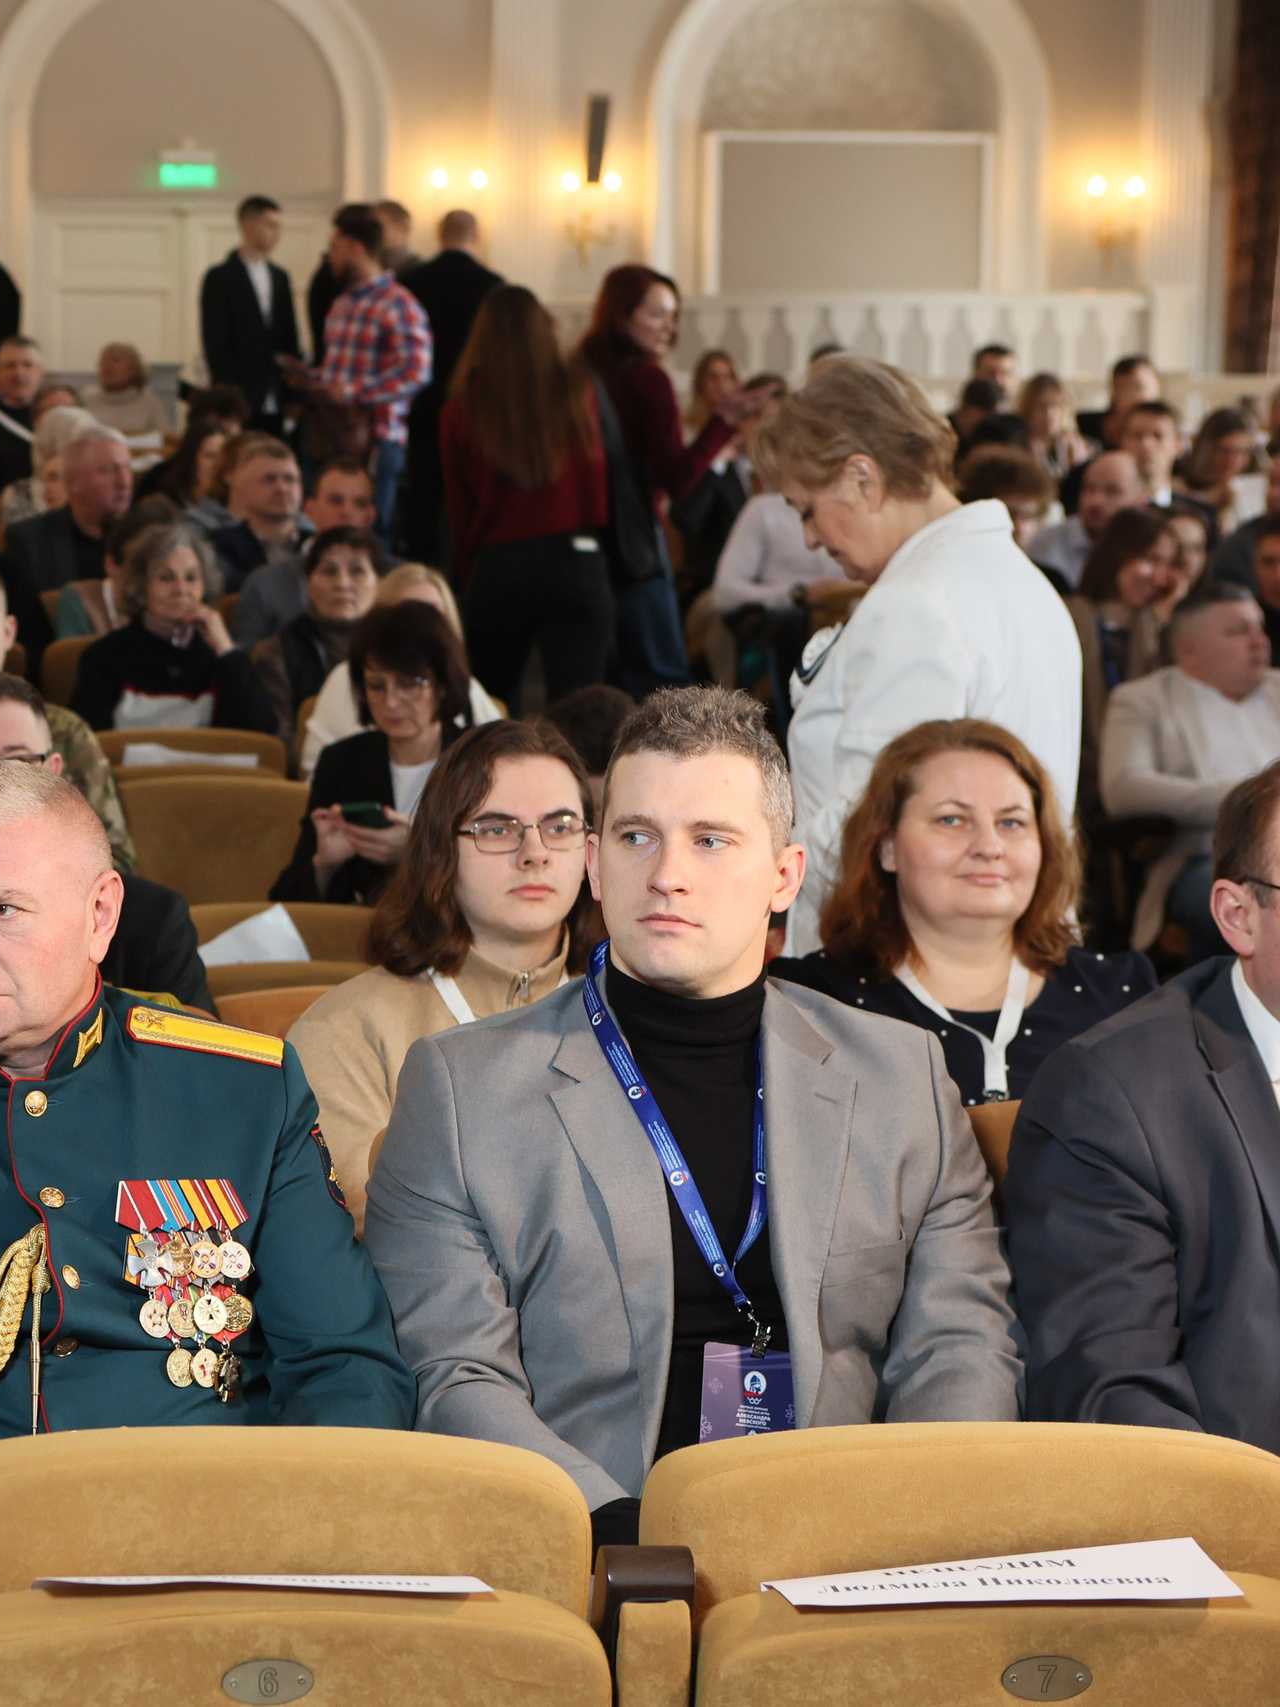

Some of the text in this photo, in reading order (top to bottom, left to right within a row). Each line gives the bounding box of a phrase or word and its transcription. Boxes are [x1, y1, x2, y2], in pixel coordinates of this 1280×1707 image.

[817, 1575, 1173, 1594] Людмила Николаевна
[258, 1667, 279, 1698] 6
[1038, 1664, 1058, 1693] 7
